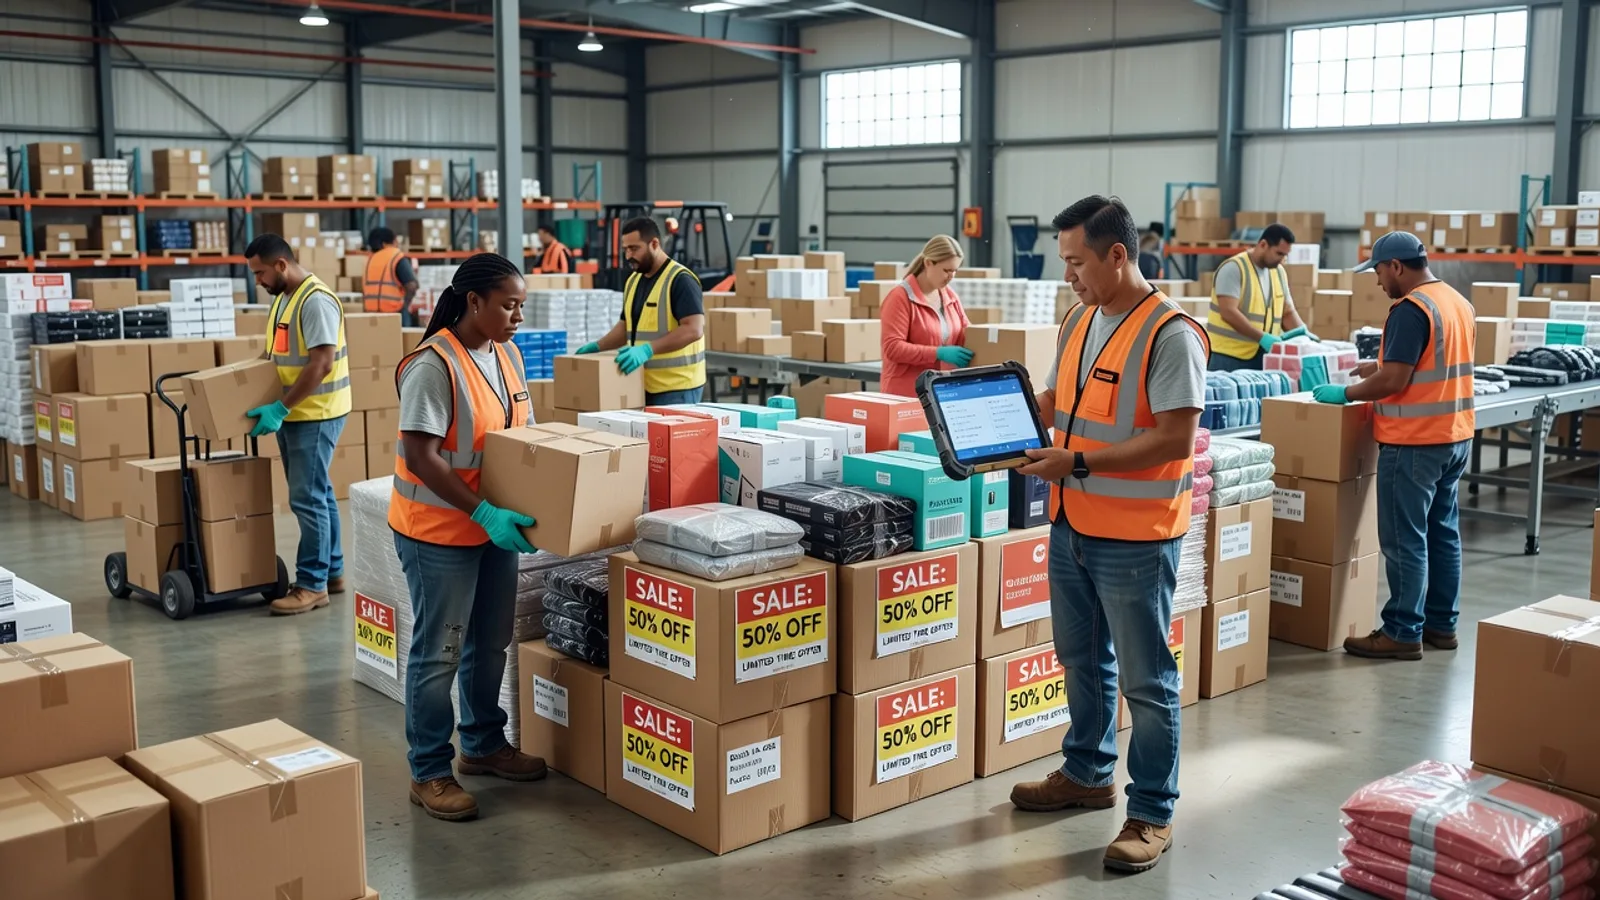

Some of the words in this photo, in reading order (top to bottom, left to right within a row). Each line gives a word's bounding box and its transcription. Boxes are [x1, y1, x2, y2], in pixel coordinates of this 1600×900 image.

[635, 577, 683, 613] SALE:
[892, 563, 946, 594] SALE:
[361, 600, 388, 627] SALE
[752, 582, 813, 616] SALE:
[883, 599, 917, 624] 50%
[922, 591, 954, 615] OFF
[629, 606, 658, 634] 50%
[661, 618, 691, 645] OFF
[742, 621, 781, 648] 50%
[786, 612, 822, 638] OFF
[892, 687, 945, 719] SALE:
[1009, 687, 1040, 711] 50%
[1043, 680, 1066, 701] OF
[633, 705, 682, 744] SALE:
[882, 724, 917, 750] 50%
[920, 713, 953, 738] OFF
[626, 733, 656, 762] 50%
[659, 747, 689, 775] OFF
